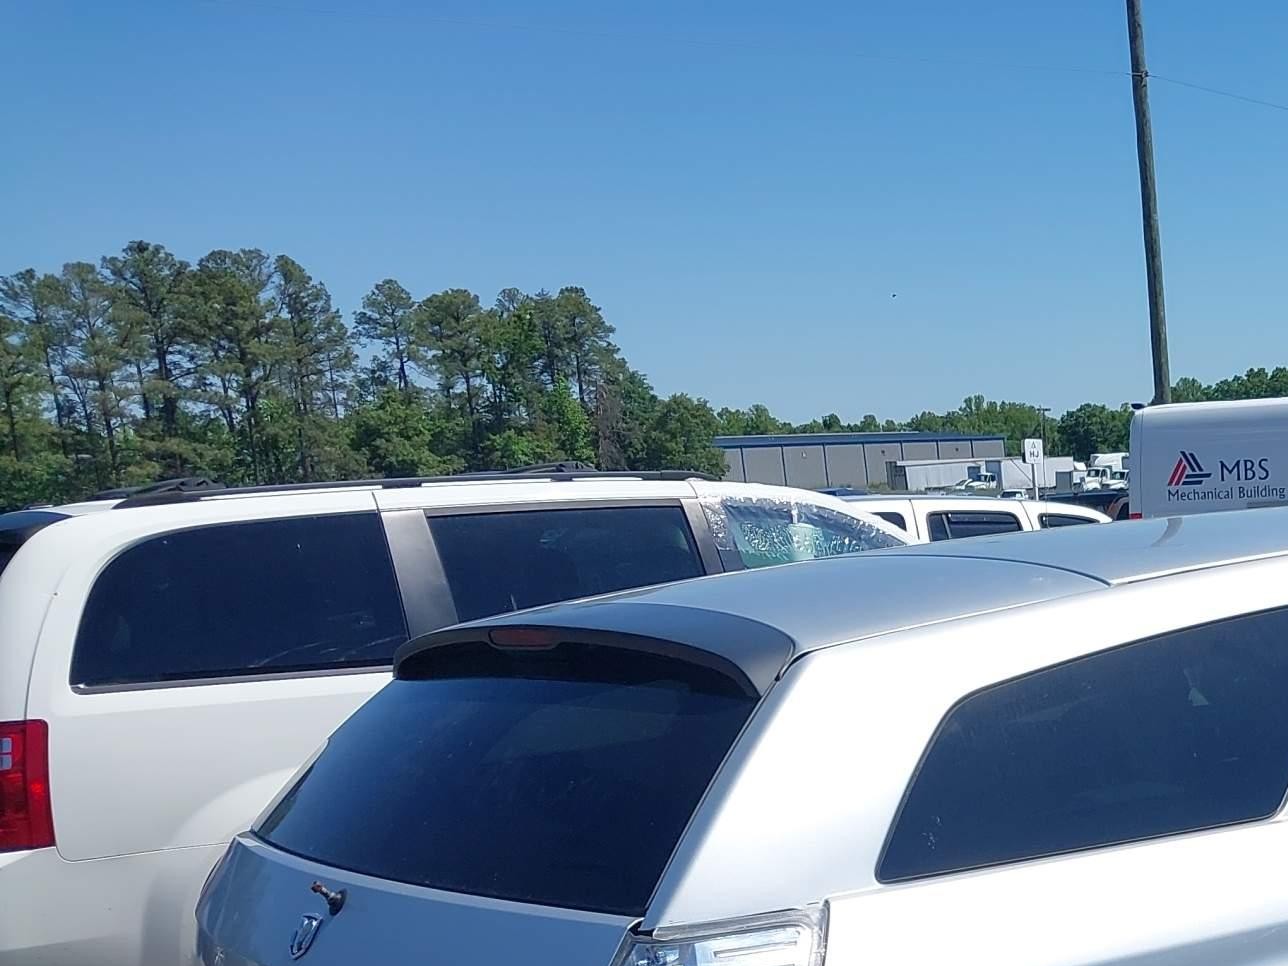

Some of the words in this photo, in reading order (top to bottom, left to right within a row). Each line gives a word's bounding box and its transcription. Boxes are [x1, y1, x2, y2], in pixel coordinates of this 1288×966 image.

[1219, 458, 1270, 482] MBS
[1167, 486, 1234, 503] Mechanical
[1238, 483, 1286, 500] Building
